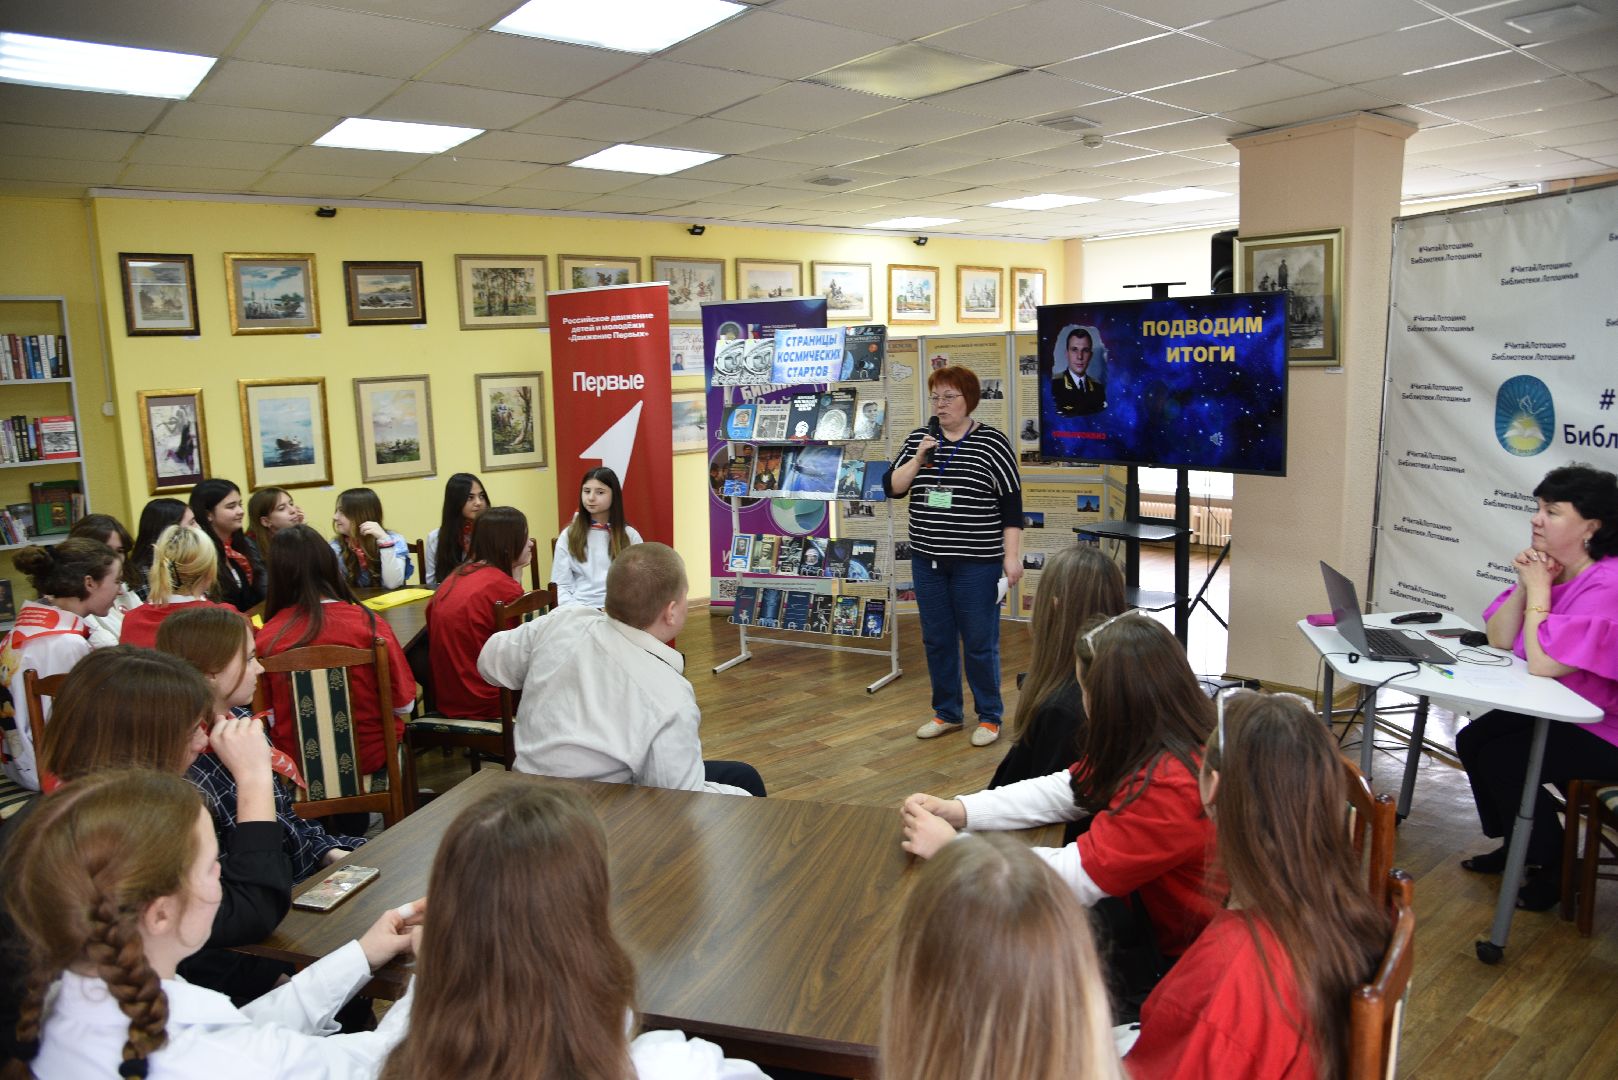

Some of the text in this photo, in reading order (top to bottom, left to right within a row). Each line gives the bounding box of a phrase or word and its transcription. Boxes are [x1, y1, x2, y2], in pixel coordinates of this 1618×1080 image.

[1410, 255, 1445, 265] Библиотеки
[1500, 276, 1541, 286] Библиотеки
[562, 313, 654, 325] Российское движение
[571, 324, 595, 333] детей
[1142, 316, 1263, 338] ПОДВОДИМ
[785, 334, 838, 347] СТРАНИЦЫ
[777, 348, 842, 363] КОСМИЧЕСКИХ
[1166, 345, 1236, 363] ИТОГИ
[1491, 353, 1534, 361] Библиотеки
[786, 365, 829, 378] СТАРТОВ
[572, 371, 645, 397] Первые
[1401, 392, 1434, 401] Библиотеки
